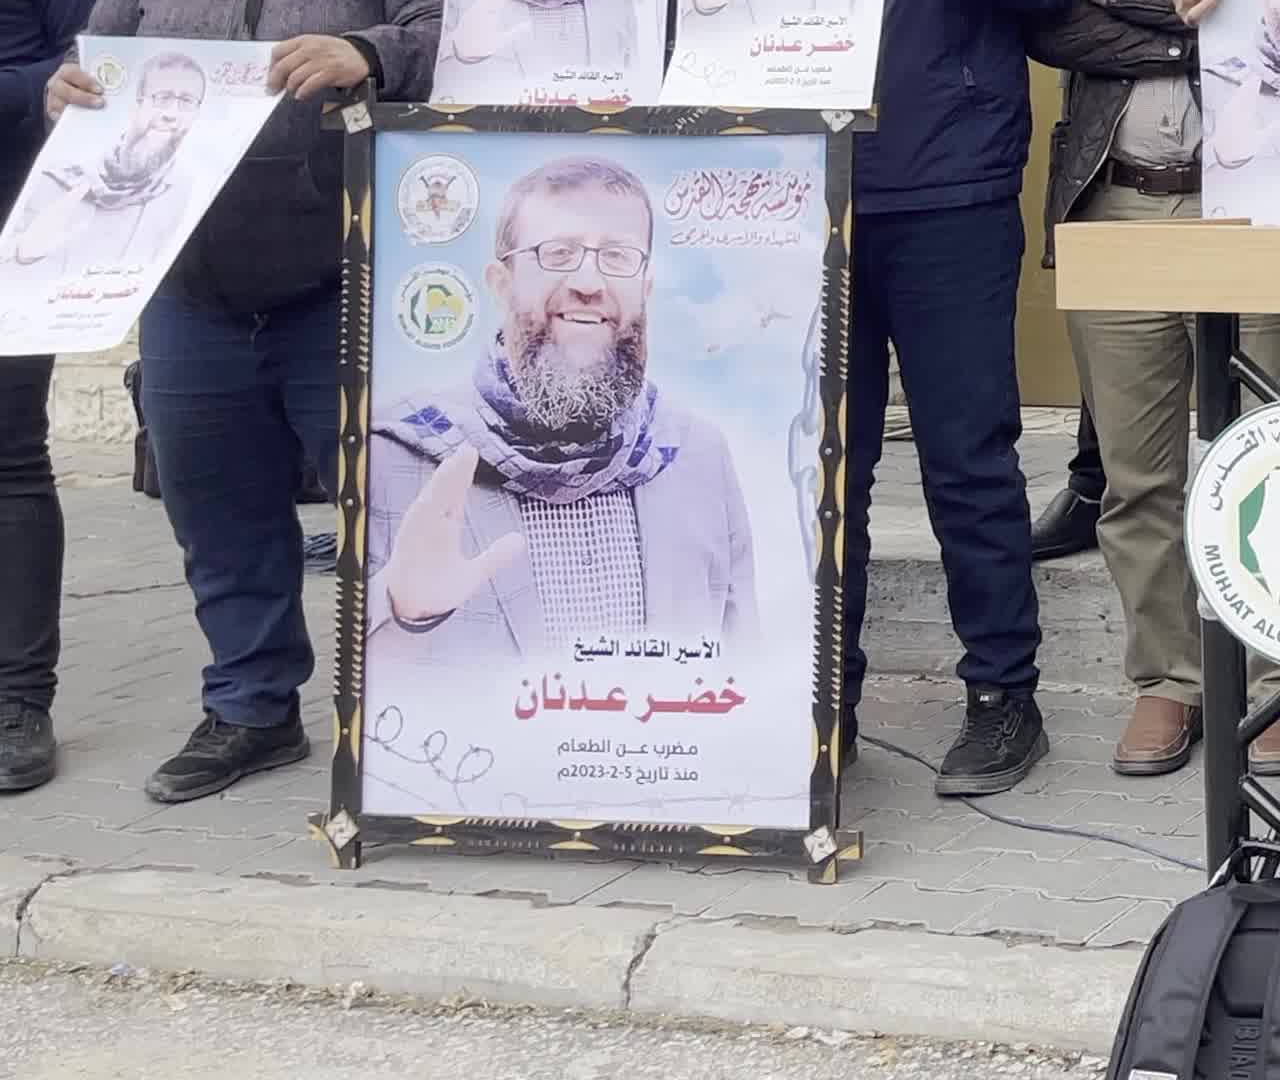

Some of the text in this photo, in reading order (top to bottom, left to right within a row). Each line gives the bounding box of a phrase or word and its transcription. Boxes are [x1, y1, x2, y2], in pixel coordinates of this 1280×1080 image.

[1204, 544, 1255, 621] MUHJAT
[574, 635, 721, 664] الأسير القائد الشيخ
[515, 672, 746, 723] خضر عدنان
[557, 738, 699, 759] مضرب عن الطعام
[636, 766, 669, 784] تاريخ
[672, 767, 699, 781] منذ
